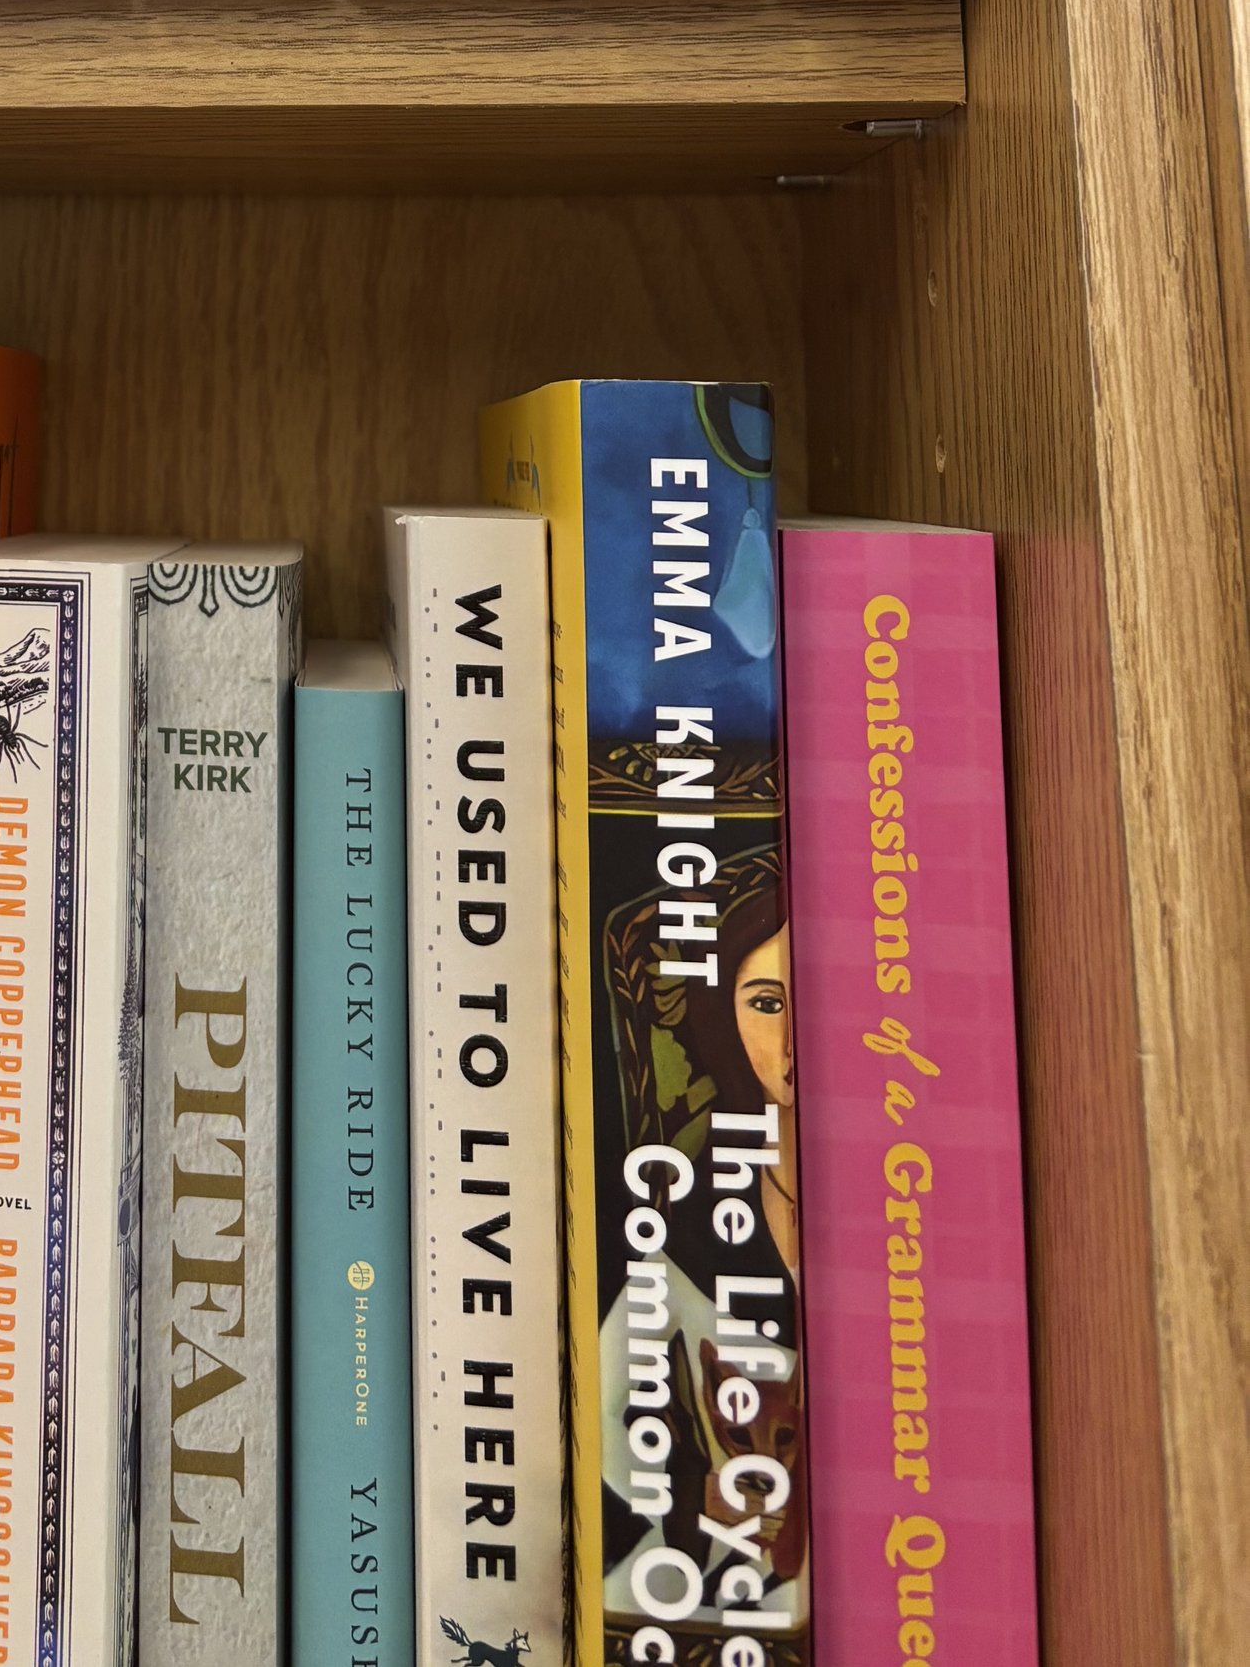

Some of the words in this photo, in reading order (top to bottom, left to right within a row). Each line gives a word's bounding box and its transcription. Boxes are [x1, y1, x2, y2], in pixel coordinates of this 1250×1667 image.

[454, 583, 505, 698] WE
[650, 457, 713, 663] EMMA
[157, 727, 268, 759] TERRY
[173, 764, 251, 792] KIRK
[862, 593, 920, 996] Confessions
[456, 740, 507, 946] USED
[654, 705, 719, 987] KNIGHT
[345, 893, 375, 1062] LUCKY
[459, 983, 510, 1088] TO
[861, 1016, 941, 1078] of
[347, 1086, 375, 1212] RIDE
[710, 1103, 780, 1245] The
[882, 1079, 916, 1127] a
[168, 972, 248, 1625] PITFALL
[459, 1128, 514, 1317] LIVE
[623, 1143, 696, 1519] Common
[714, 1274, 789, 1425] Life
[883, 1141, 934, 1495] Grammar
[463, 1359, 517, 1583] HERE
